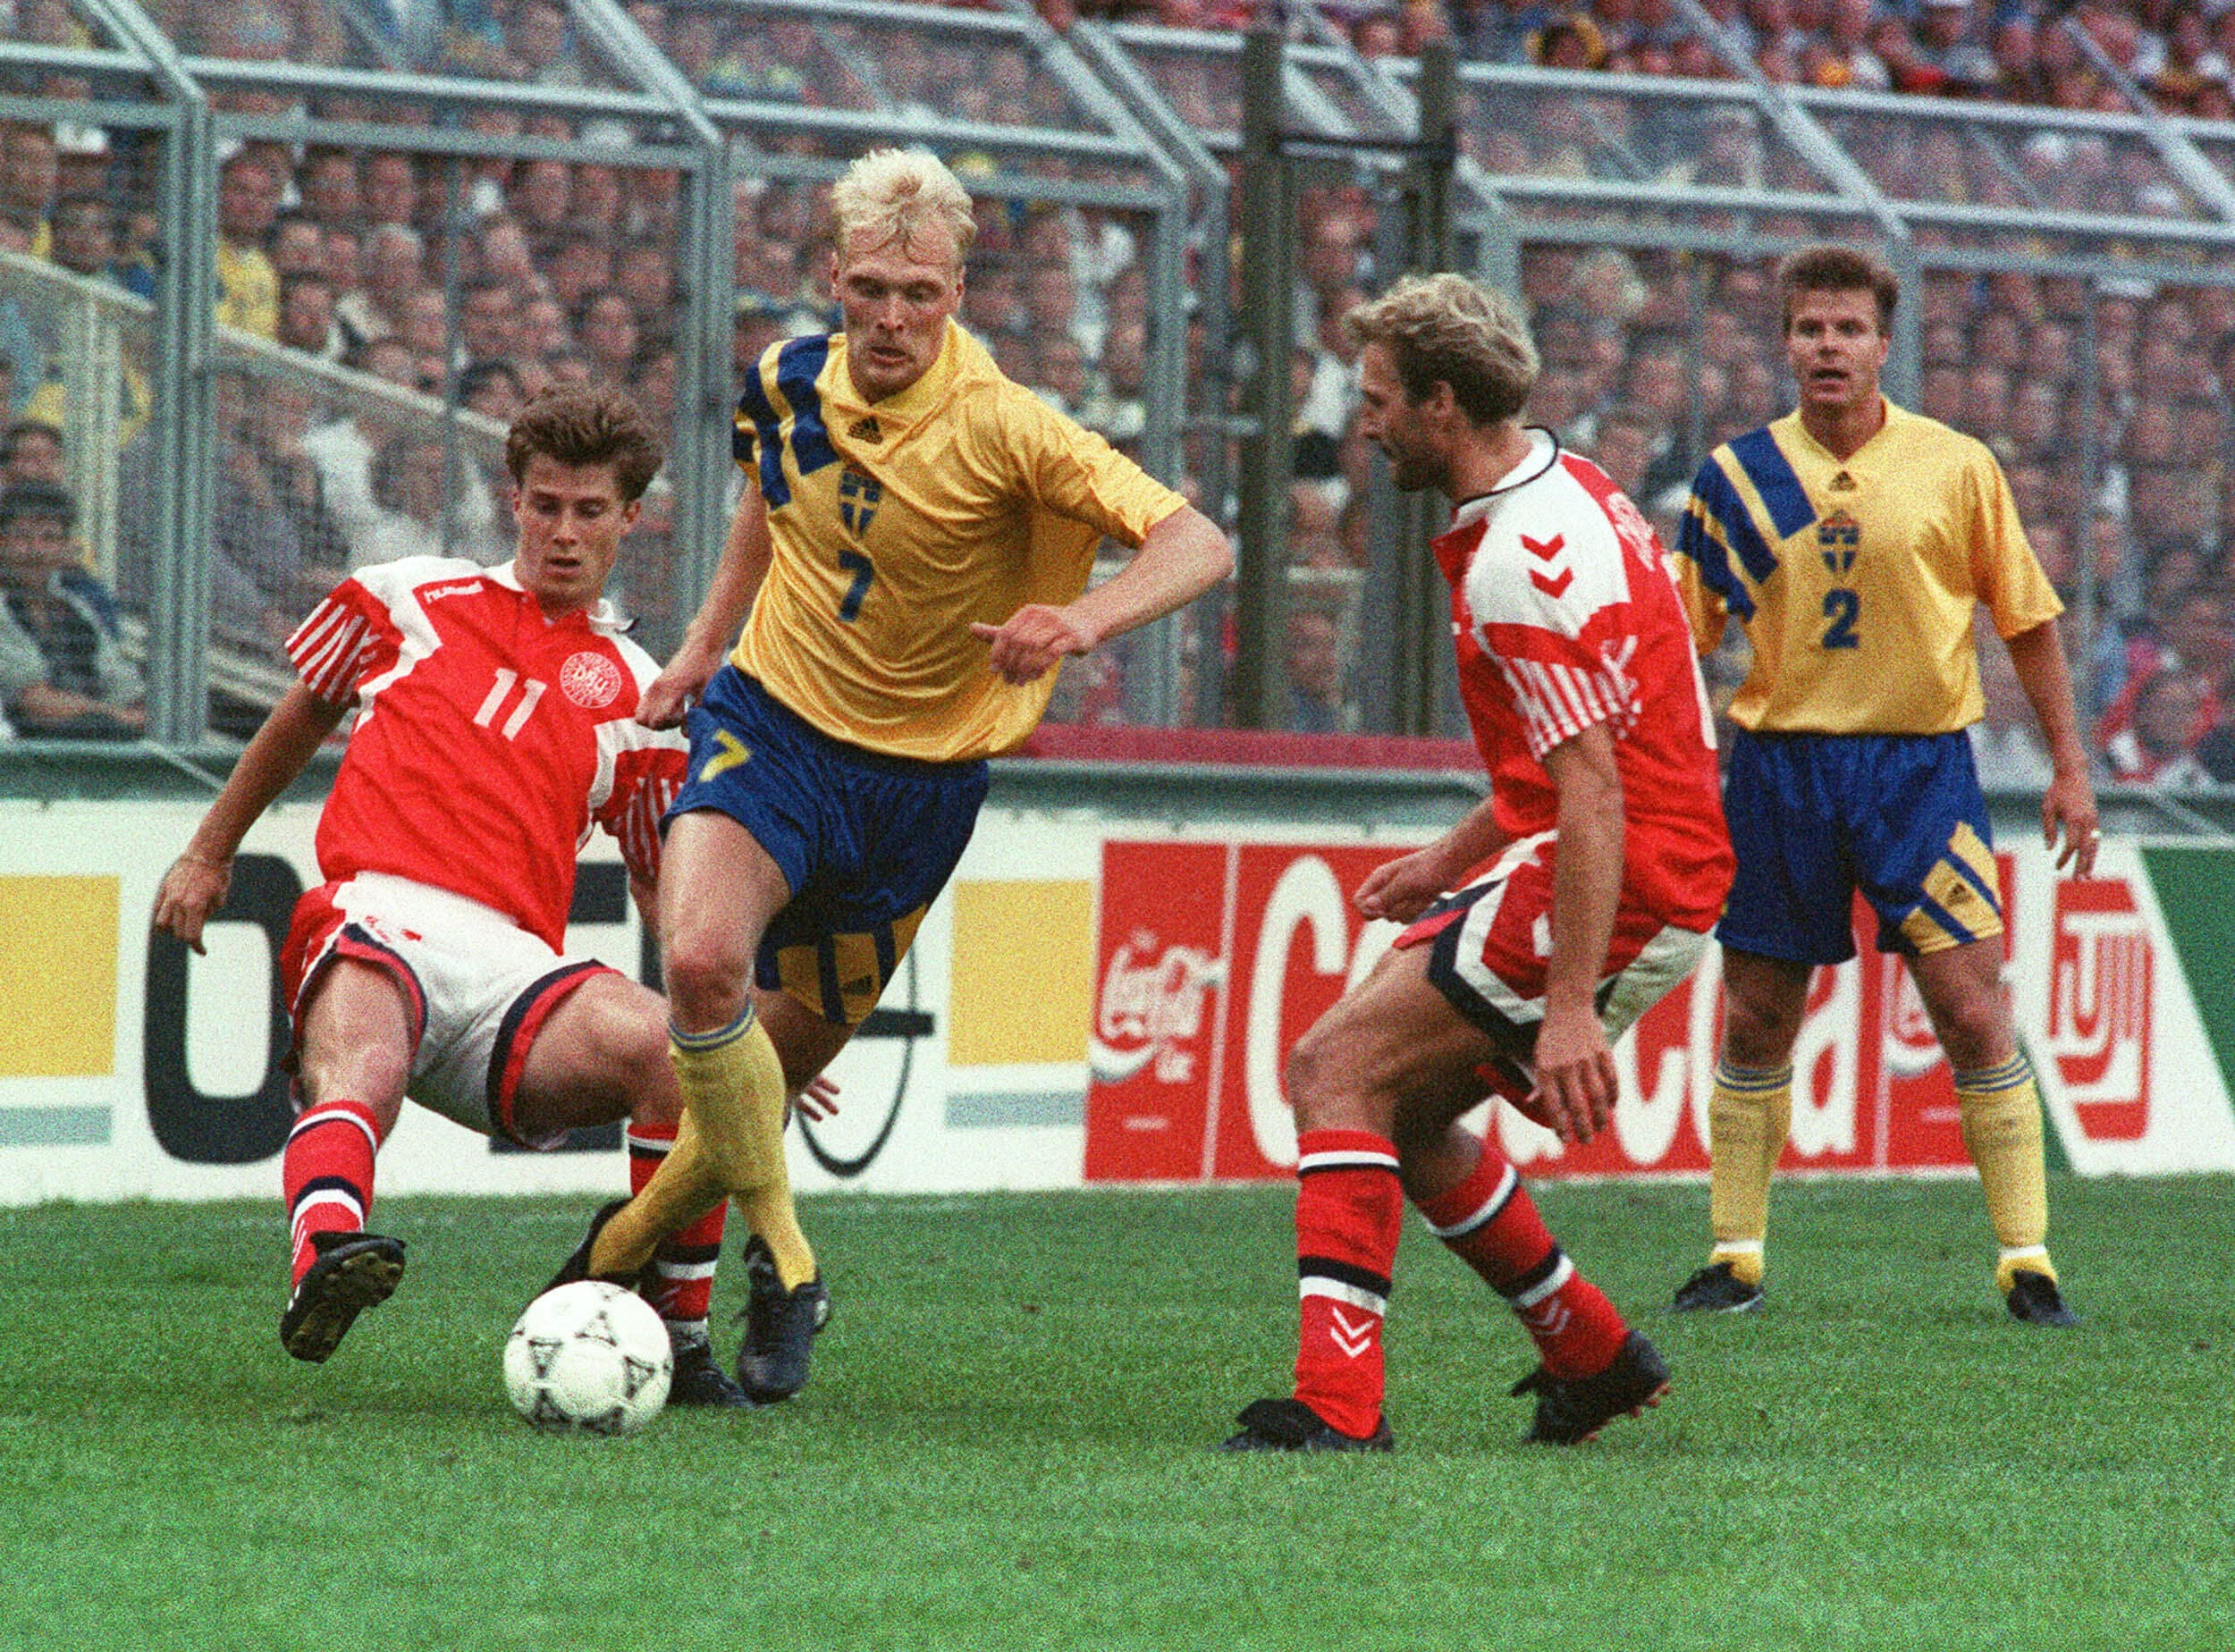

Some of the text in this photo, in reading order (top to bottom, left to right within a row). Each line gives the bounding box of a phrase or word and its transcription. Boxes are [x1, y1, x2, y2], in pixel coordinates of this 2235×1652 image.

[837, 549, 873, 622] 7
[1822, 588, 1860, 650] 2
[474, 667, 547, 741] 11
[699, 730, 752, 783] 7
